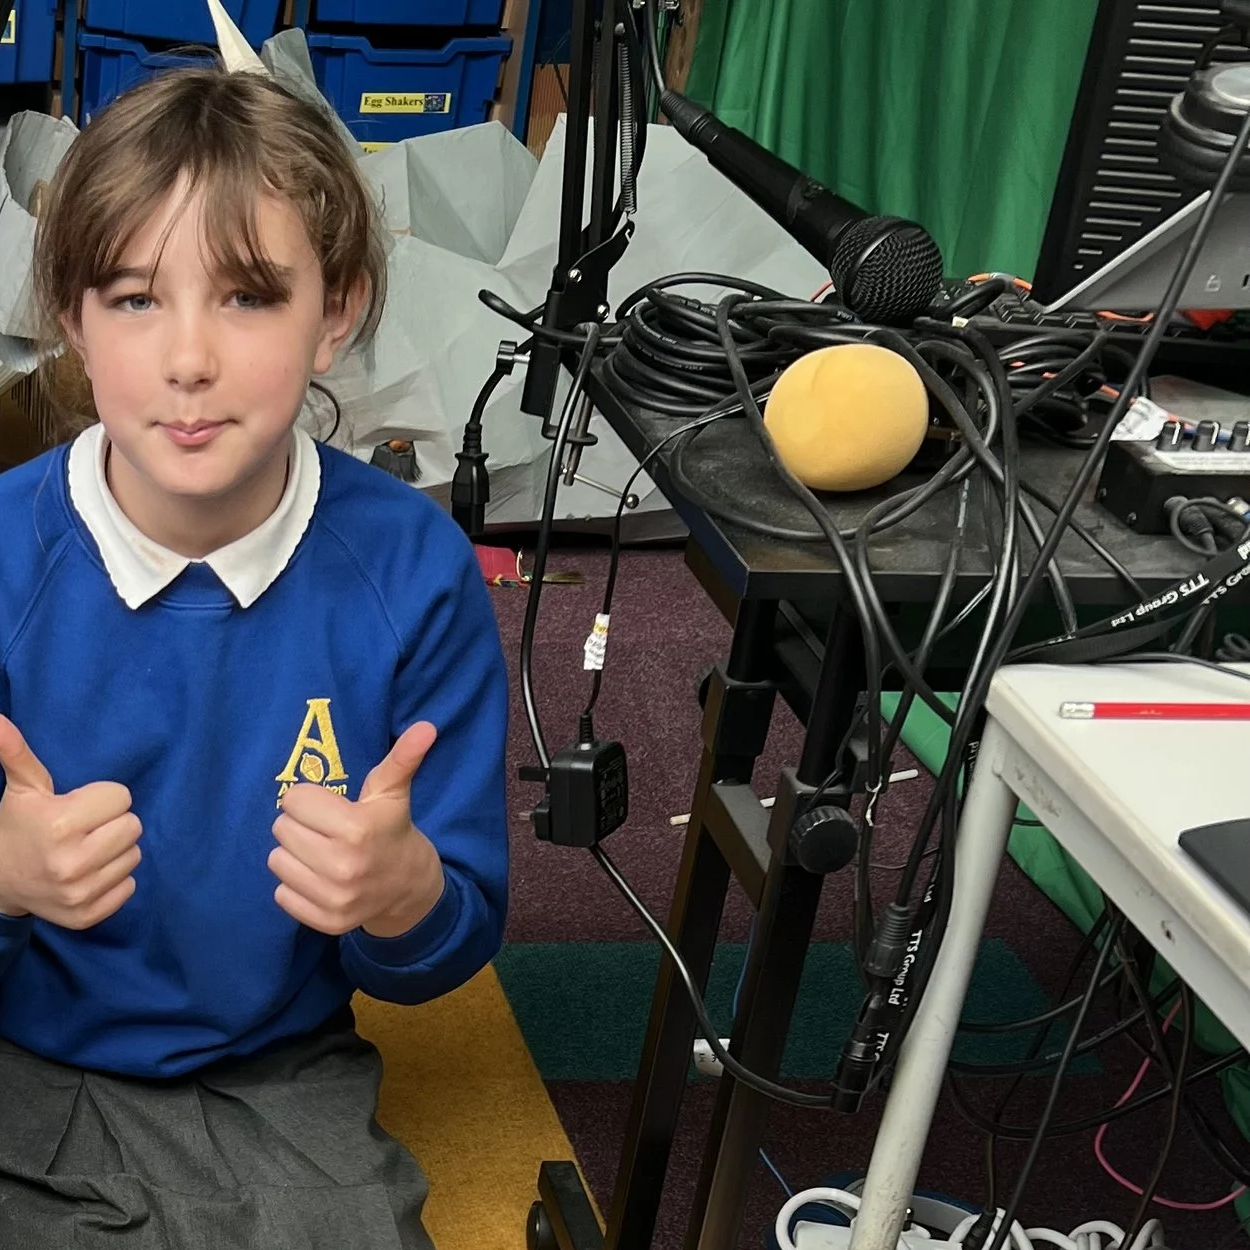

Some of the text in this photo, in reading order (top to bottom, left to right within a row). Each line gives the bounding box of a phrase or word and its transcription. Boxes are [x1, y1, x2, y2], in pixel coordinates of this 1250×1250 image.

[364, 96, 424, 108] Egg Shakers
[1110, 573, 1210, 627] TTS Group Ltd
[906, 929, 923, 952] TTS
[888, 987, 905, 1006] Ltd
